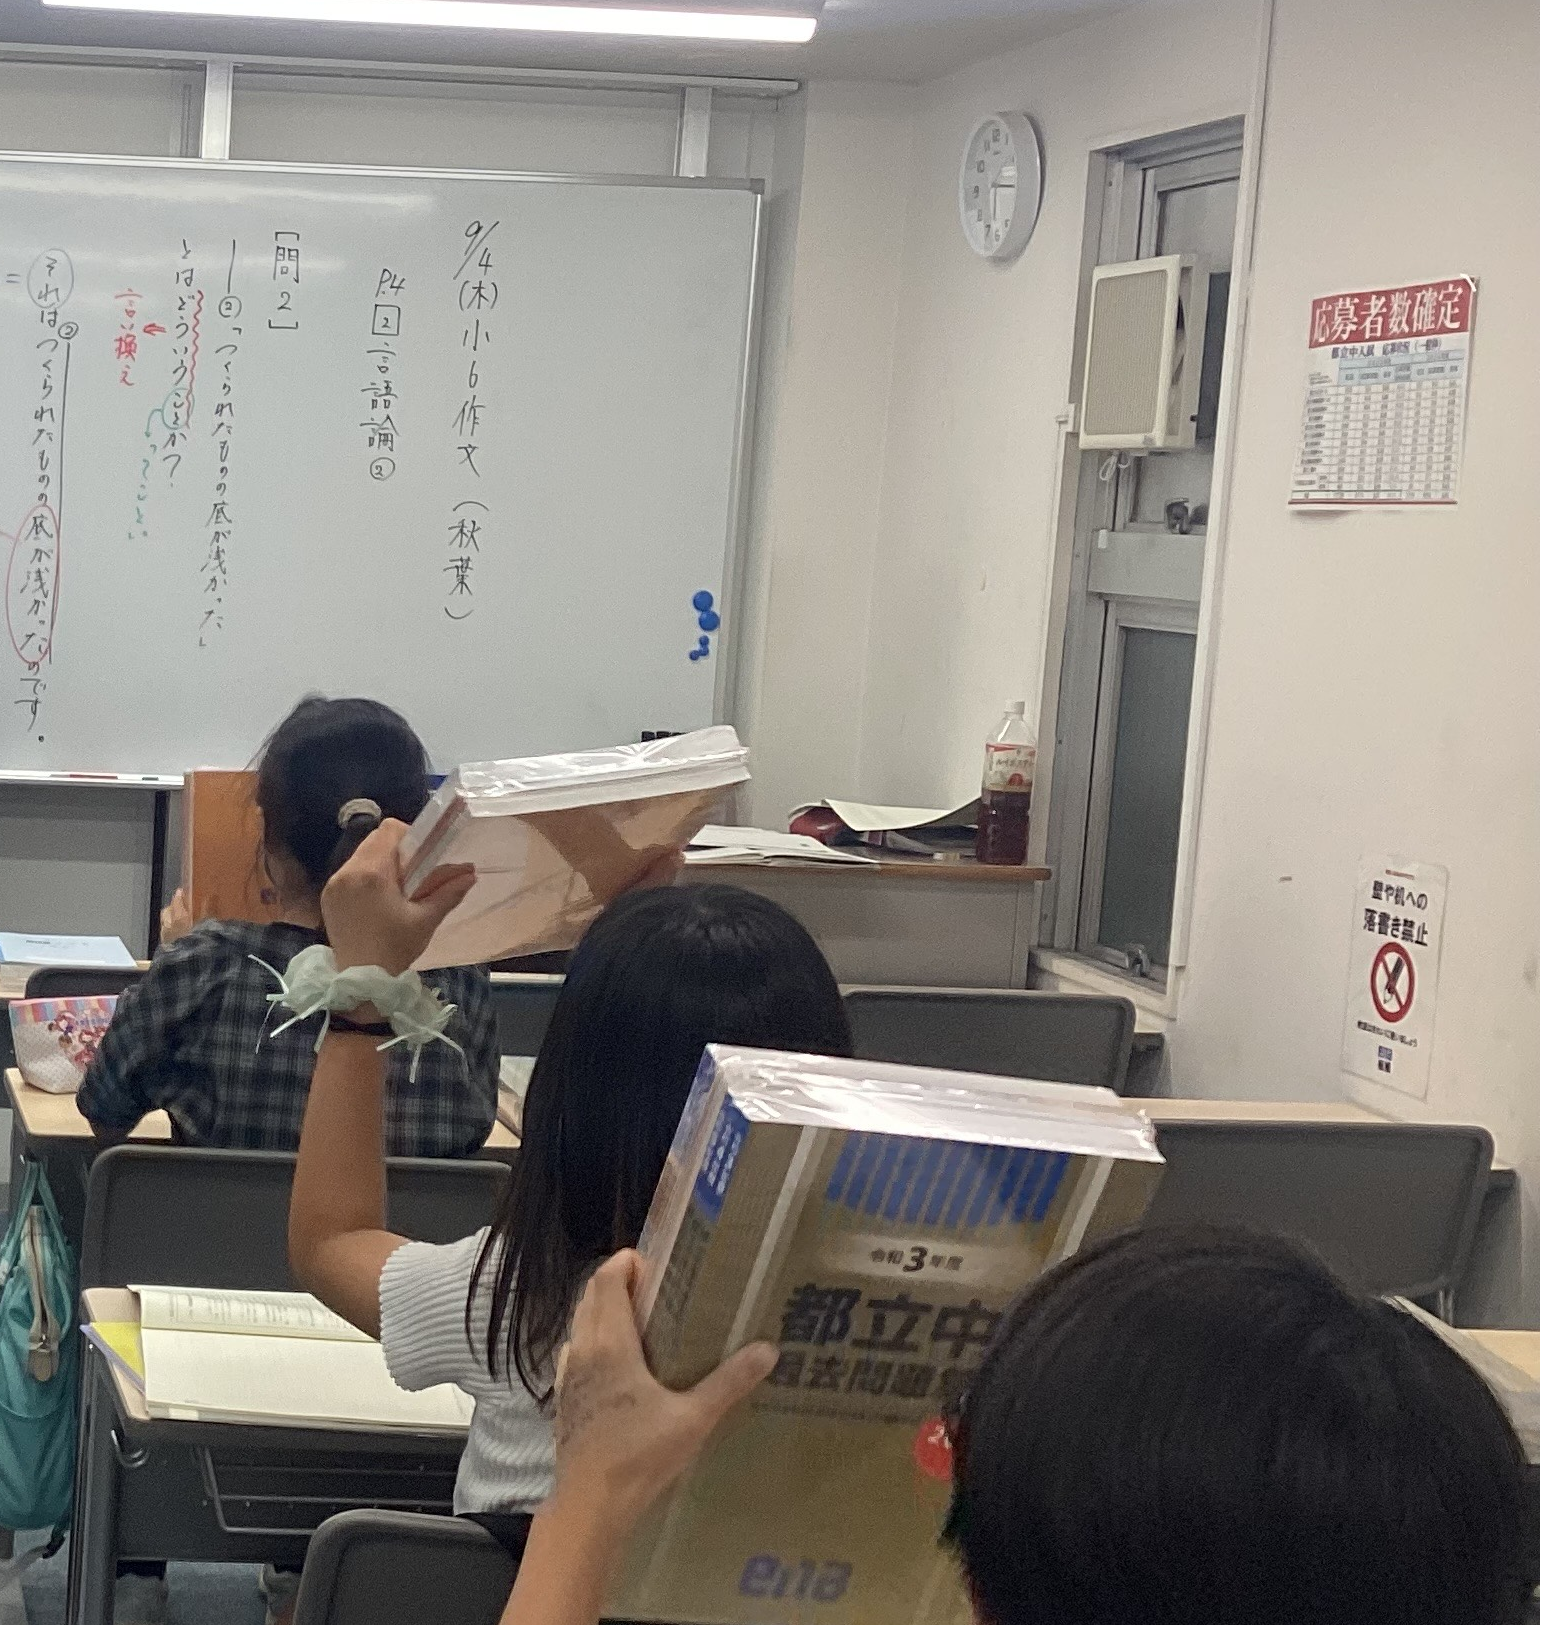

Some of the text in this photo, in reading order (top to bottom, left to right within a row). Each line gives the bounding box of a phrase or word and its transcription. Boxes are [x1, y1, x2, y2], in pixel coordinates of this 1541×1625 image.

[114, 287, 144, 387] 言い換え
[1312, 283, 1463, 344] 応募者数確定
[1370, 879, 1429, 912] 壁や机への
[1362, 907, 1430, 948] 落書き禁止
[739, 1554, 854, 1604] ena
